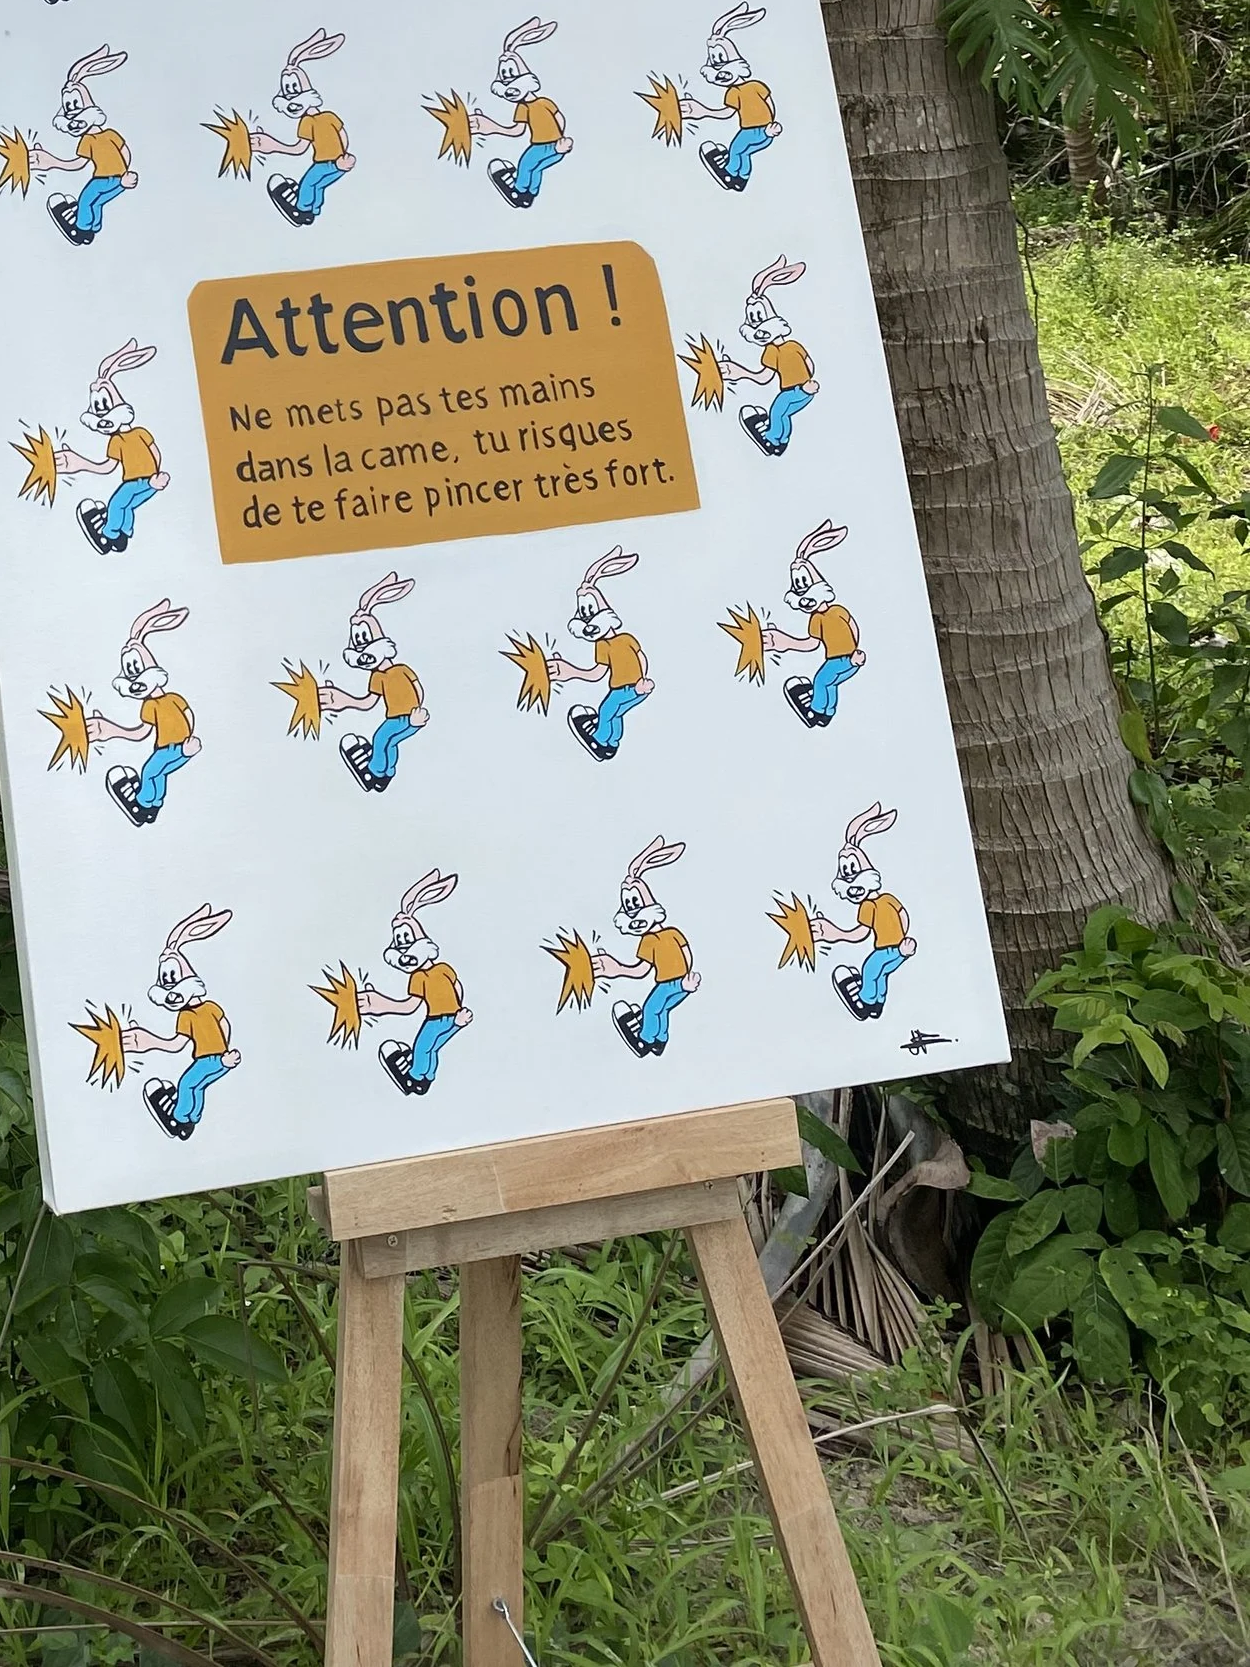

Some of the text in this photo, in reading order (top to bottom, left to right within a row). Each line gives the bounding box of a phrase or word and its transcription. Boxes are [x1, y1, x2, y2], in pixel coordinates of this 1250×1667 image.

[220, 264, 621, 365] Attention !
[229, 373, 595, 432] Ne mets pas tes mains
[235, 418, 633, 484] dans la came, tu risques
[242, 458, 675, 529] de te faire pincer très fort.
